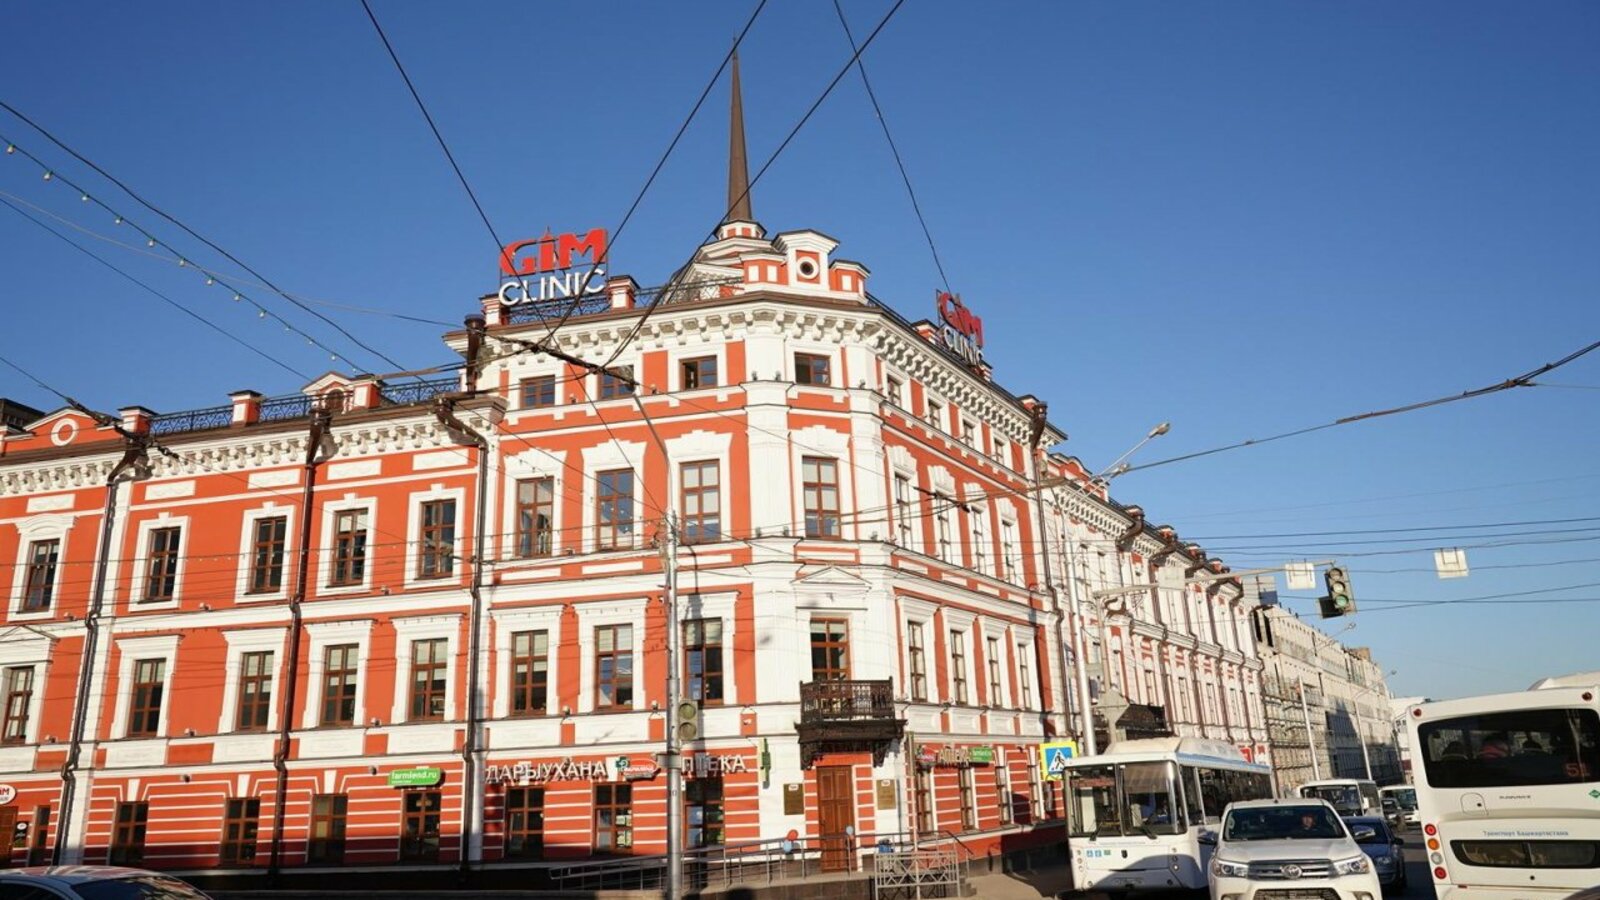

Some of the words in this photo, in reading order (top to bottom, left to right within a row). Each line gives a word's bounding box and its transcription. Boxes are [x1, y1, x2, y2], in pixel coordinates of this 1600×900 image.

[498, 268, 606, 306] CLINIC
[485, 761, 607, 784] ДАРЫУХАНА
[681, 754, 746, 773] ПТЕКА
